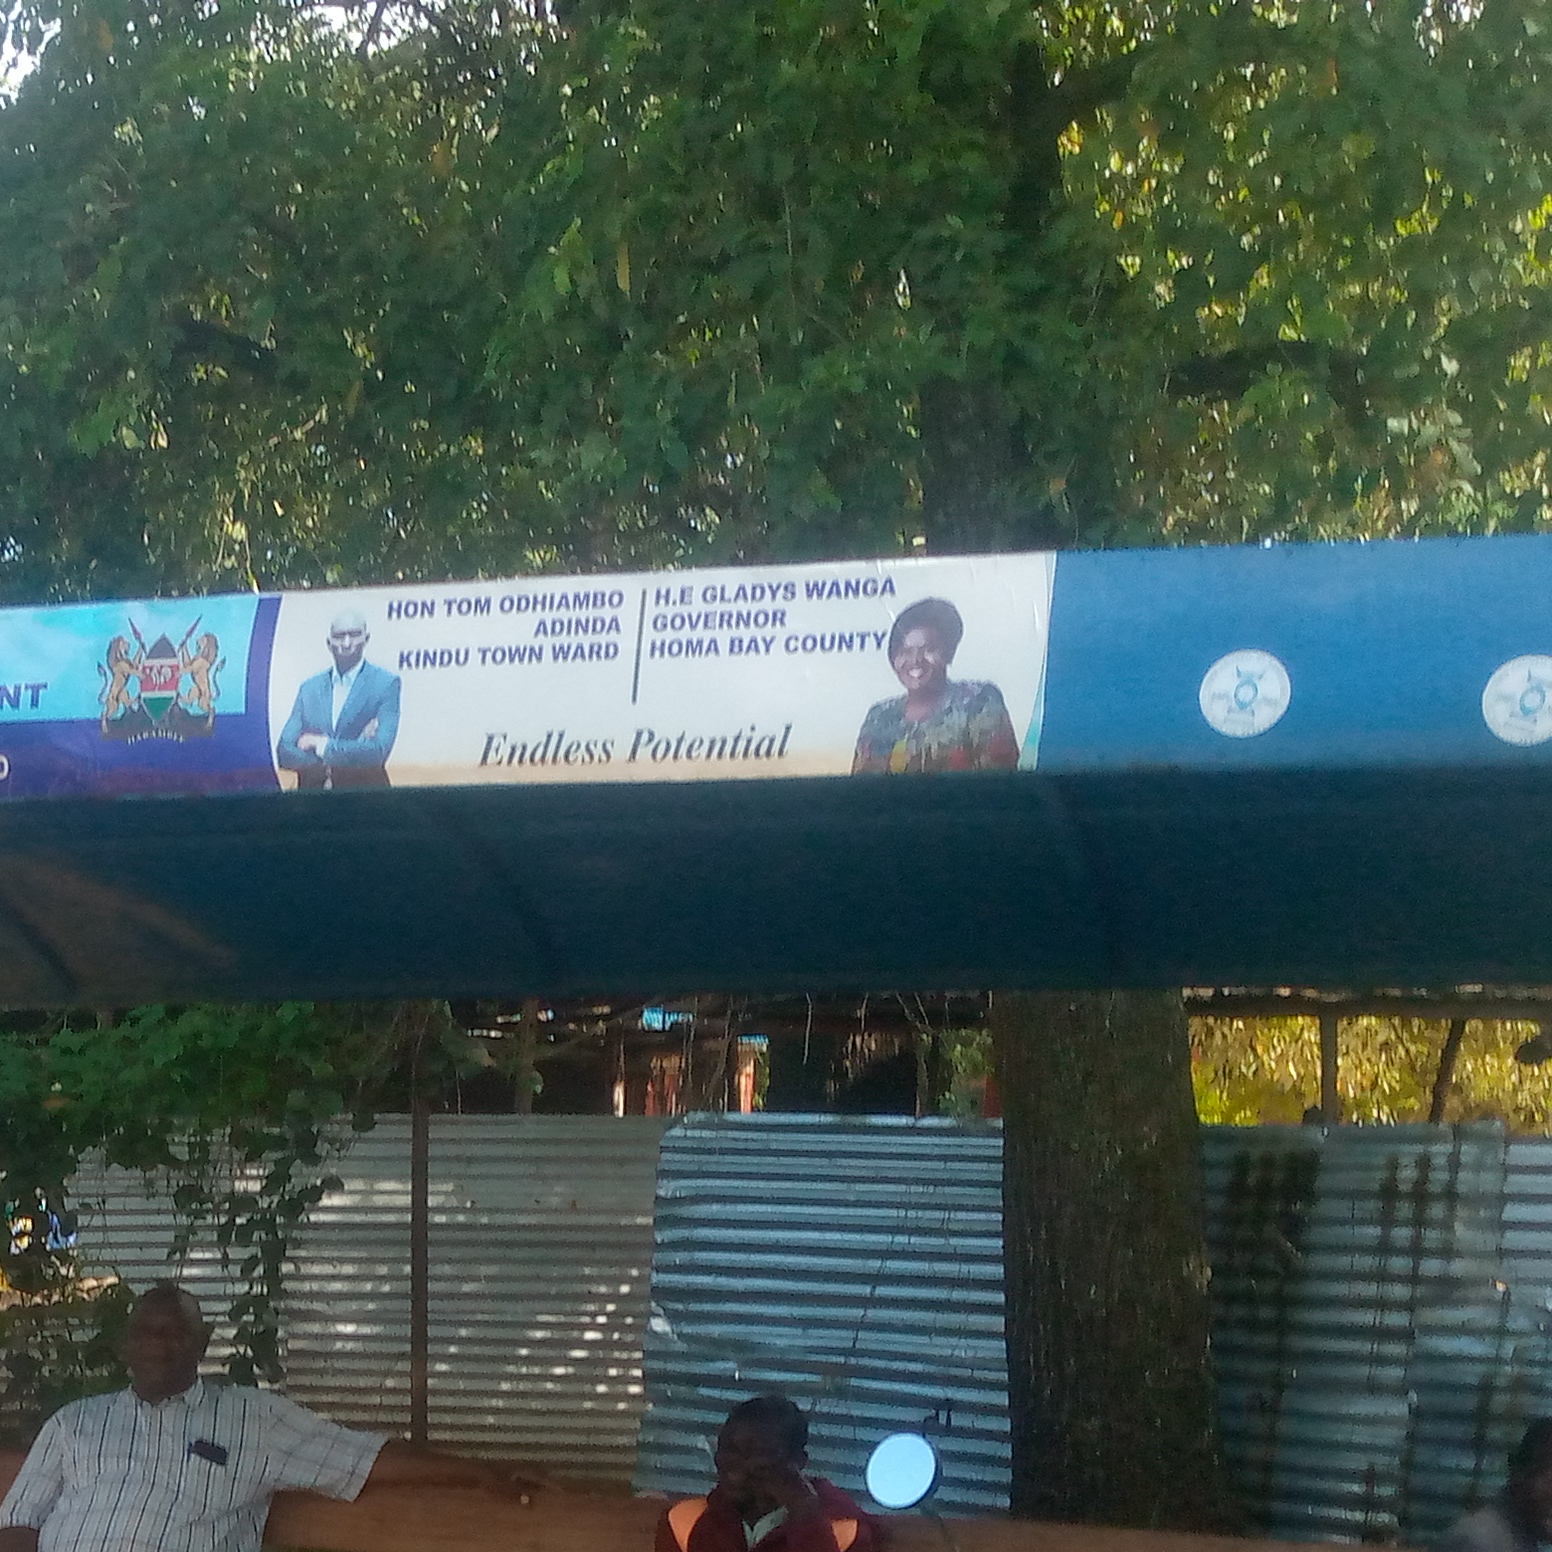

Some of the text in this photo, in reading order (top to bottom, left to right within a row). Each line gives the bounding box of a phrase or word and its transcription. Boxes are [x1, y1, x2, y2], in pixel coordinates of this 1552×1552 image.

[387, 588, 625, 620] HON TOM ODHIAMBO
[701, 580, 797, 605] GLADYS
[804, 575, 896, 601] WANGA
[532, 614, 622, 638] ADINDA
[652, 607, 788, 633] GOVERNOR
[398, 640, 620, 671] KINDU TOWN WARD
[648, 628, 888, 660] HOMA BAY COUNTY
[477, 722, 793, 767] Endless Potential
